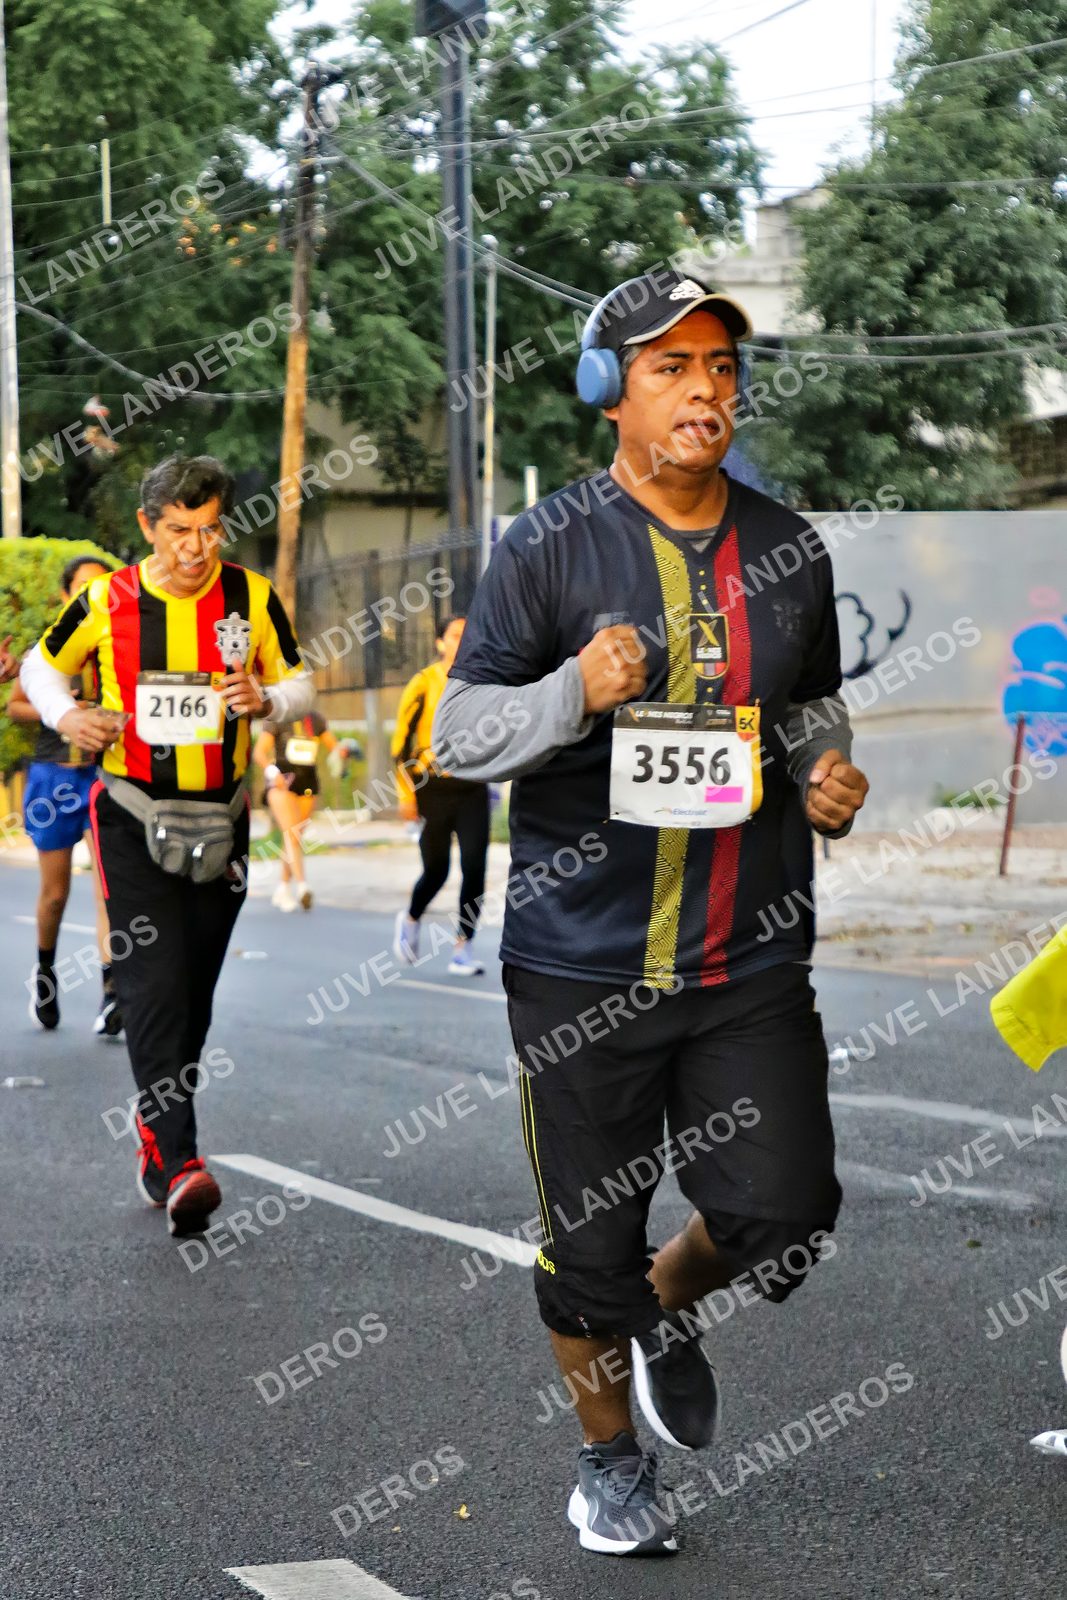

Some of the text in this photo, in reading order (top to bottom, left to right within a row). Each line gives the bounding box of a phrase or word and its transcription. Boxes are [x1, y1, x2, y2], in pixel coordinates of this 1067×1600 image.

[149, 694, 207, 718] 2166
[739, 718, 755, 731] 5K
[632, 744, 731, 786] 3556
